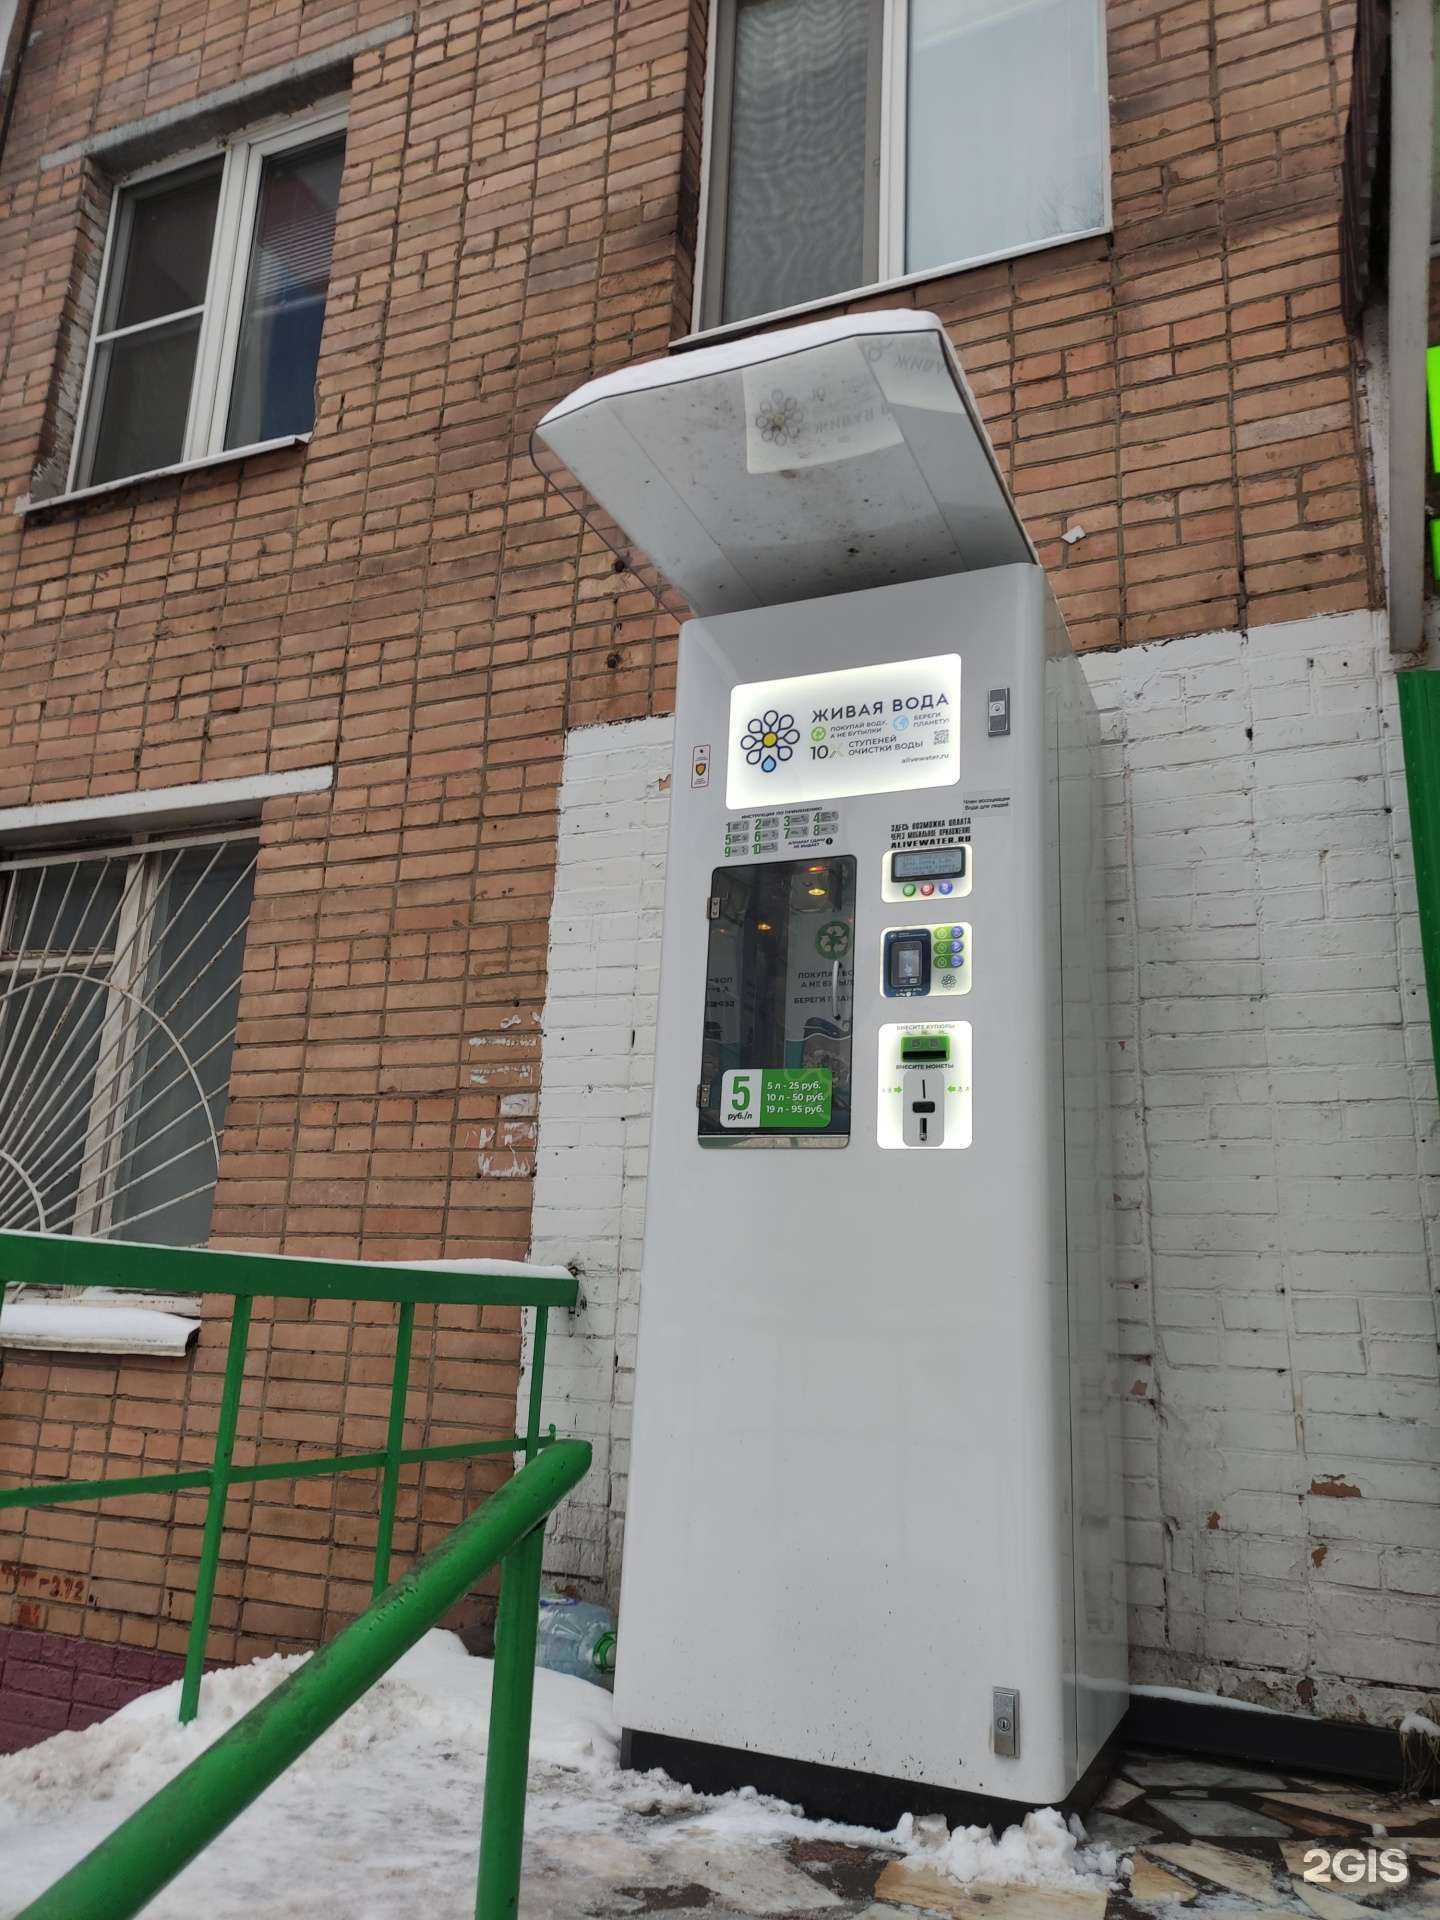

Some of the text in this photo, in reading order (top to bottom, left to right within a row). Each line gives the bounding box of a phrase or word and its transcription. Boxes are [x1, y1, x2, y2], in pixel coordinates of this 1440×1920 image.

[812, 693, 949, 723] ЖИВАЯ ВОДА
[830, 721, 865, 732] ПОКУПАЙ
[848, 727, 882, 738] БУТЫЛКИ
[849, 735, 896, 748] СТУПЕНЕЙ
[810, 745, 828, 760] 10
[848, 741, 924, 756] ОЧИСТКИ ВОДЫ
[784, 816, 790, 826] 3
[813, 812, 820, 824] 4
[755, 818, 761, 830] 2
[891, 824, 909, 832] ЗДЕСЬ
[754, 831, 761, 842] 6
[784, 828, 790, 839] 7
[725, 834, 732, 845] 5
[891, 836, 972, 849] ALIVEWATER.RU
[725, 847, 731, 858] 9
[802, 1080, 820, 1092] руб.
[732, 1076, 750, 1110] 5
[806, 1092, 826, 1103] руб.
[766, 1105, 776, 1113] 19
[792, 1104, 802, 1113] 95
[804, 1104, 824, 1115] руб.
